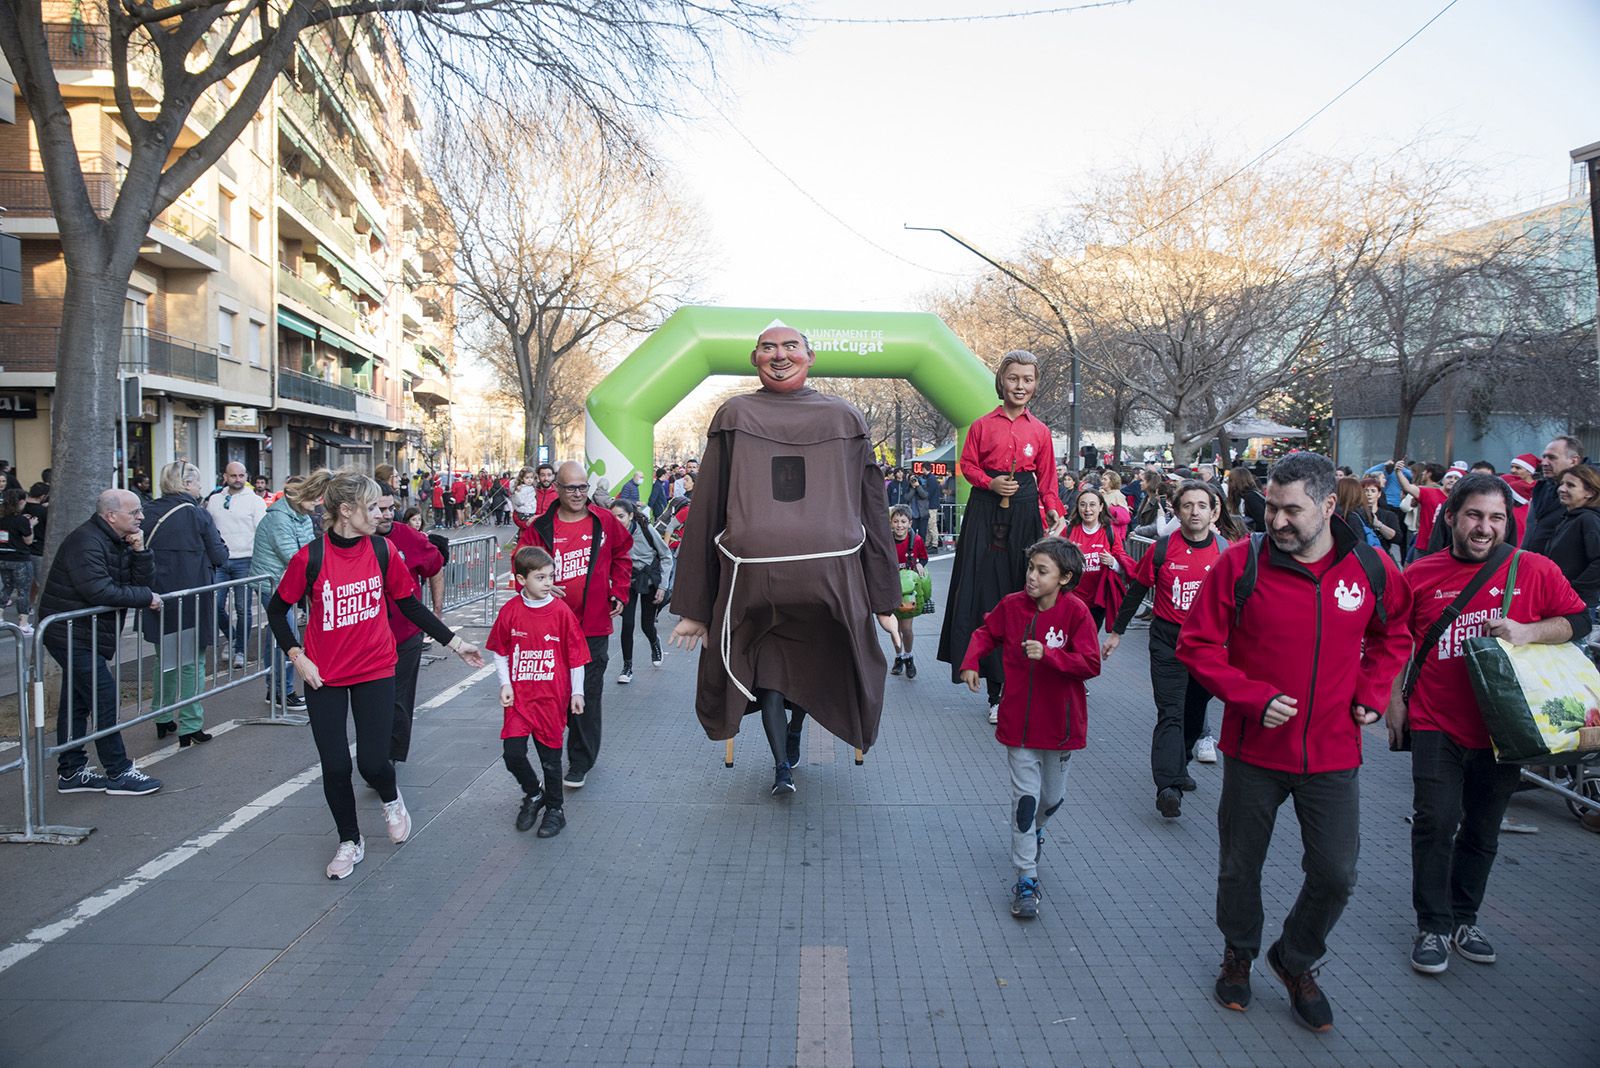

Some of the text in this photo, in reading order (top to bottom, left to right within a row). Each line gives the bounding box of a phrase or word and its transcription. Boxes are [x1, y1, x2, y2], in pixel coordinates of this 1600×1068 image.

[804, 328, 883, 340] AJUNTAMENT DE
[563, 547, 591, 561] CURSA DE
[563, 556, 587, 573] GALL
[562, 567, 589, 580] SANT CUG
[336, 576, 382, 598] CURSA DEL
[1182, 581, 1202, 590] CURS
[1182, 590, 1197, 602] GA
[337, 592, 371, 616] GALL
[1181, 602, 1192, 610] SA
[336, 613, 359, 628] SANT
[1455, 607, 1503, 627] CURSA DE
[1453, 624, 1484, 645] GAL
[520, 649, 554, 659] CURSA DEL
[1453, 645, 1465, 657] SA
[519, 660, 545, 672] GALL
[517, 672, 555, 681] SANT CUGAT
